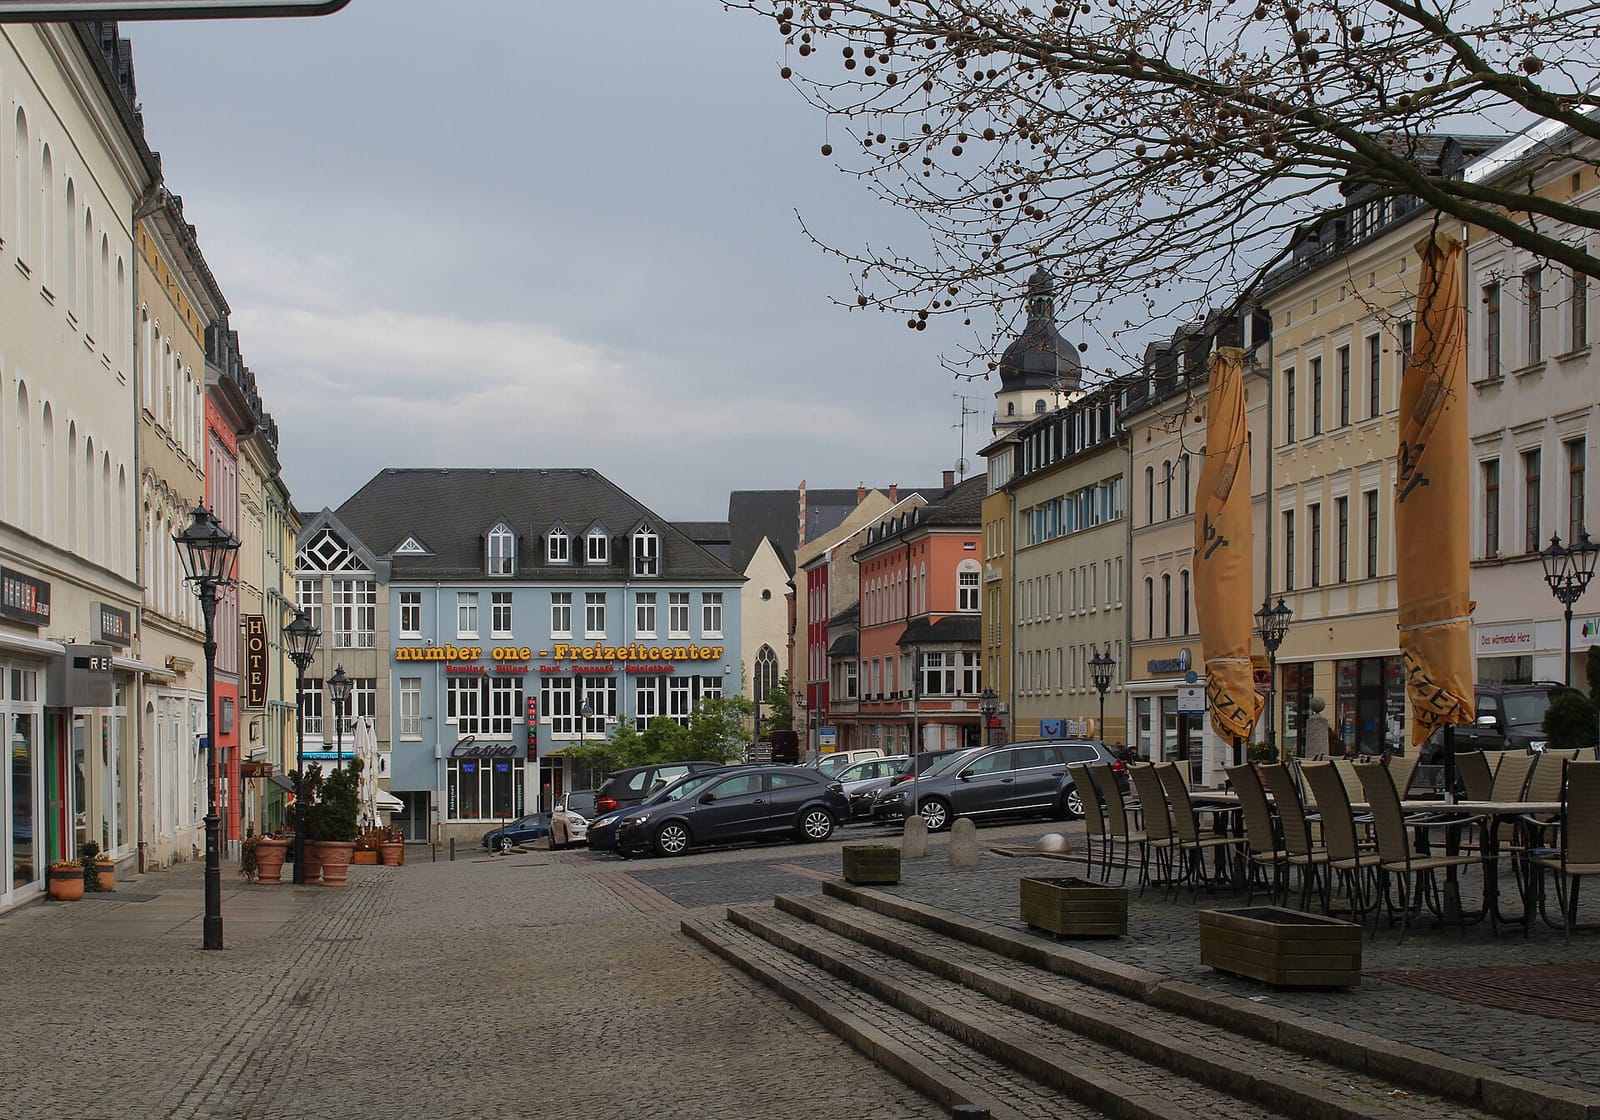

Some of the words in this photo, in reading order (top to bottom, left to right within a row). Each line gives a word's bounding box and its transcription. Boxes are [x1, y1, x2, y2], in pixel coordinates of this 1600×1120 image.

[1481, 635, 1491, 645] Das
[1518, 632, 1530, 642] Herz
[395, 643, 482, 661] number
[492, 646, 531, 661] one
[553, 642, 723, 661] Freizeitcenter
[249, 620, 263, 703] HOTEL
[445, 665, 485, 674] Bowling
[495, 665, 528, 673] Billard
[539, 664, 560, 673] Dart
[451, 735, 517, 757] Casino
